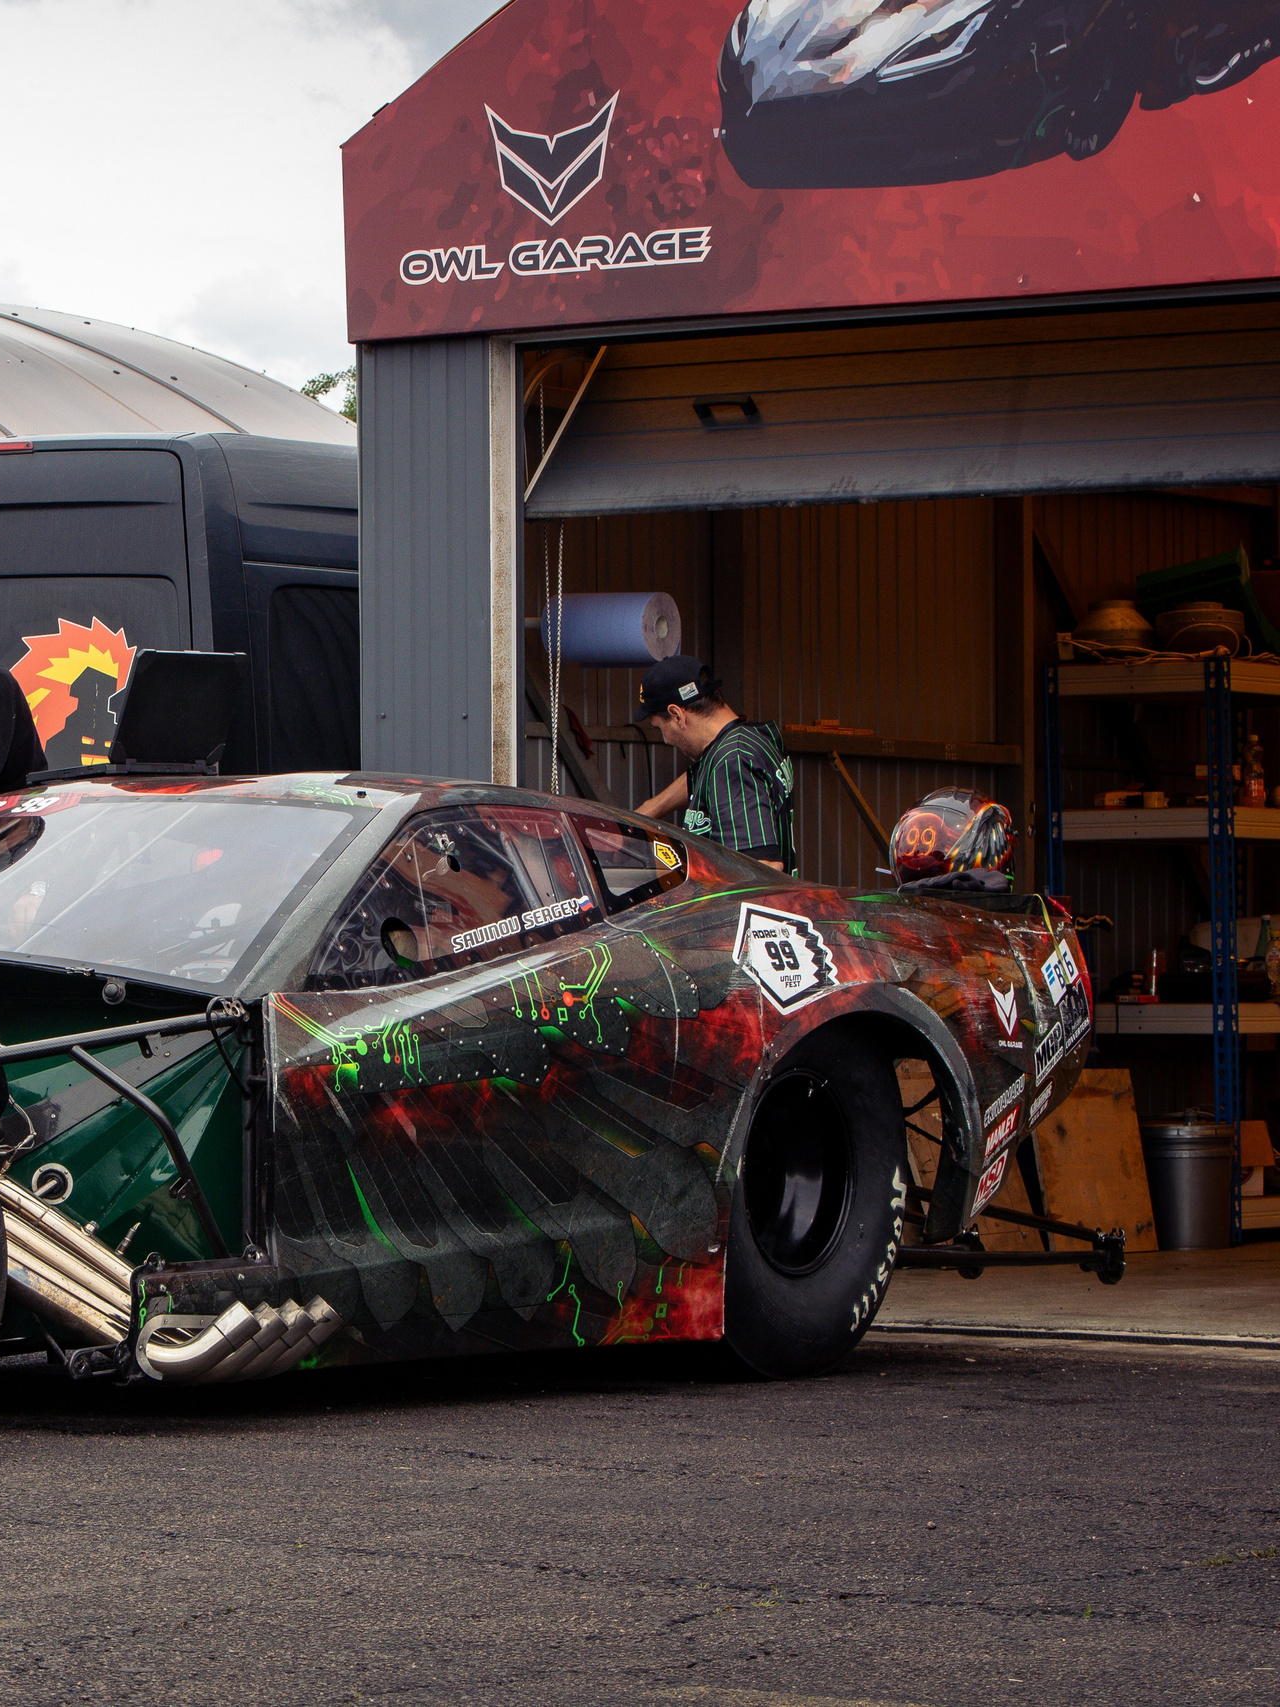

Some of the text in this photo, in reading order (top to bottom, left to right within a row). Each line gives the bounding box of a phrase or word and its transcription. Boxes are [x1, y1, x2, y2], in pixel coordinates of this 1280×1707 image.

[399, 226, 713, 286] OWL GARAGE
[11, 796, 61, 813] 99
[904, 825, 937, 857] 99
[521, 897, 580, 931] SERGEY
[764, 940, 801, 972] 99
[780, 974, 802, 983] UNLIM
[784, 981, 801, 989] FEST
[984, 1110, 1018, 1157] MANLEY
[976, 1153, 1006, 1203] MSD
